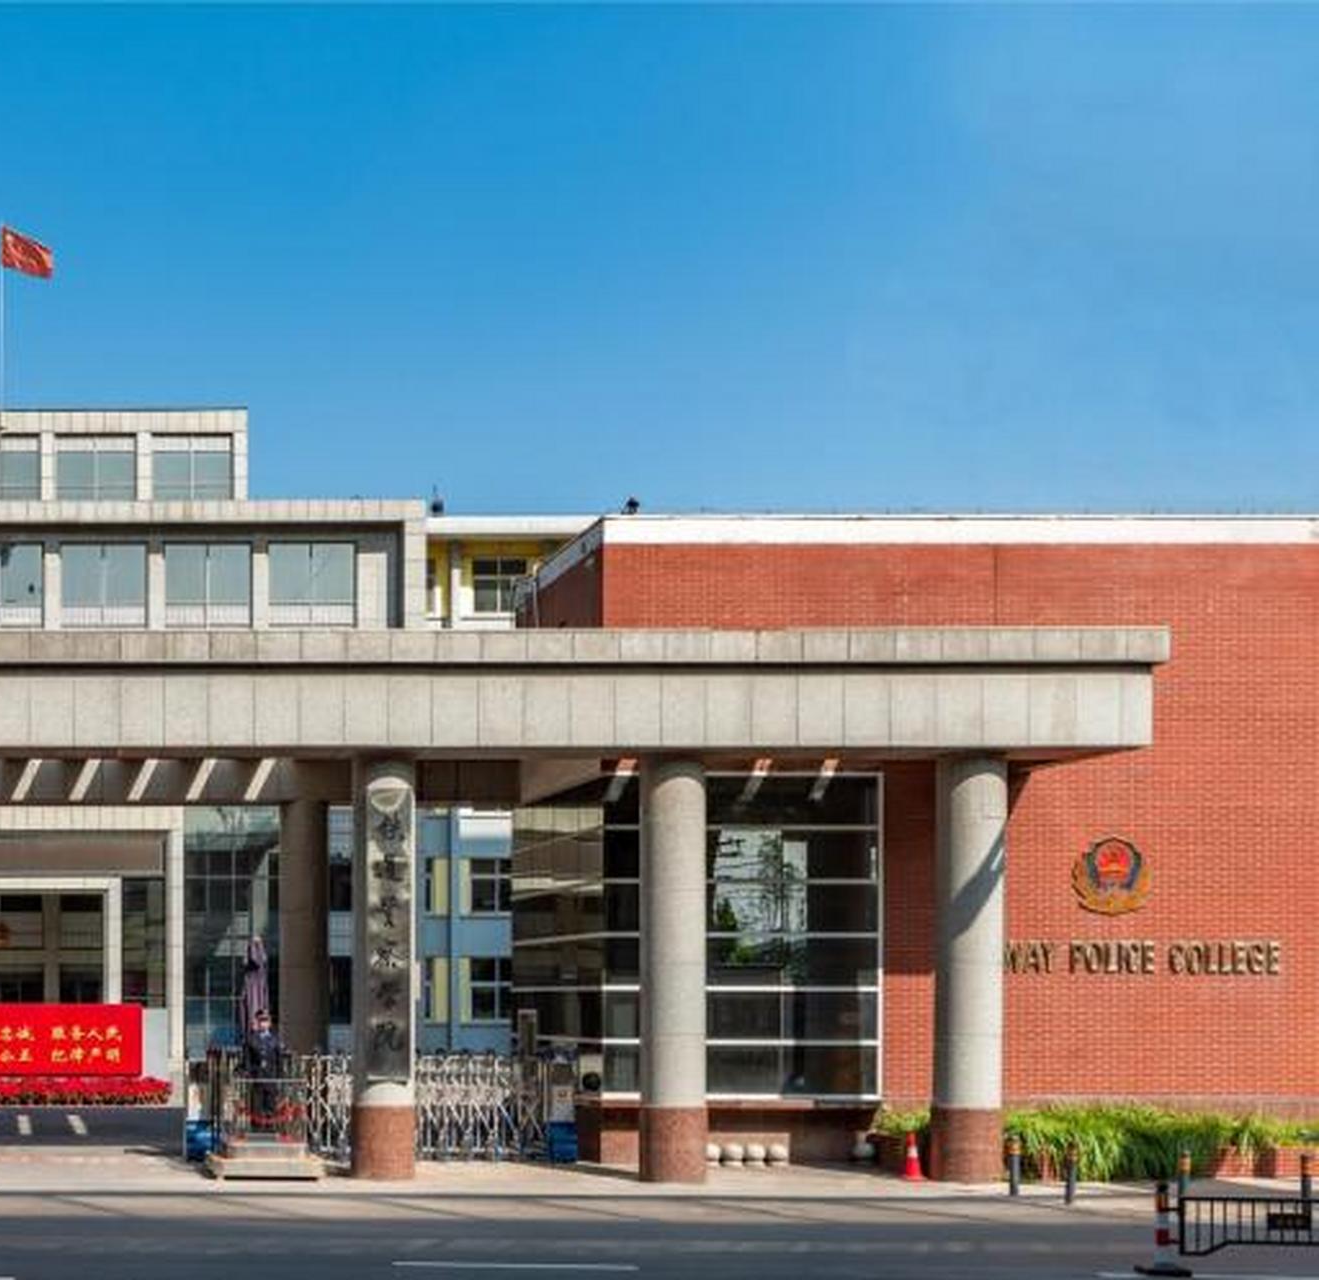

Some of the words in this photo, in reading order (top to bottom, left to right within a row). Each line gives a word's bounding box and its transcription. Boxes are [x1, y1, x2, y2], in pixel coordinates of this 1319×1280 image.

[371, 812, 409, 1052] 铁道警察学院
[1068, 939, 1155, 975] POLICE
[1168, 940, 1280, 976] COLLEGE
[51, 1024, 123, 1043] 服务人民
[51, 1046, 121, 1064] 纪律严明
